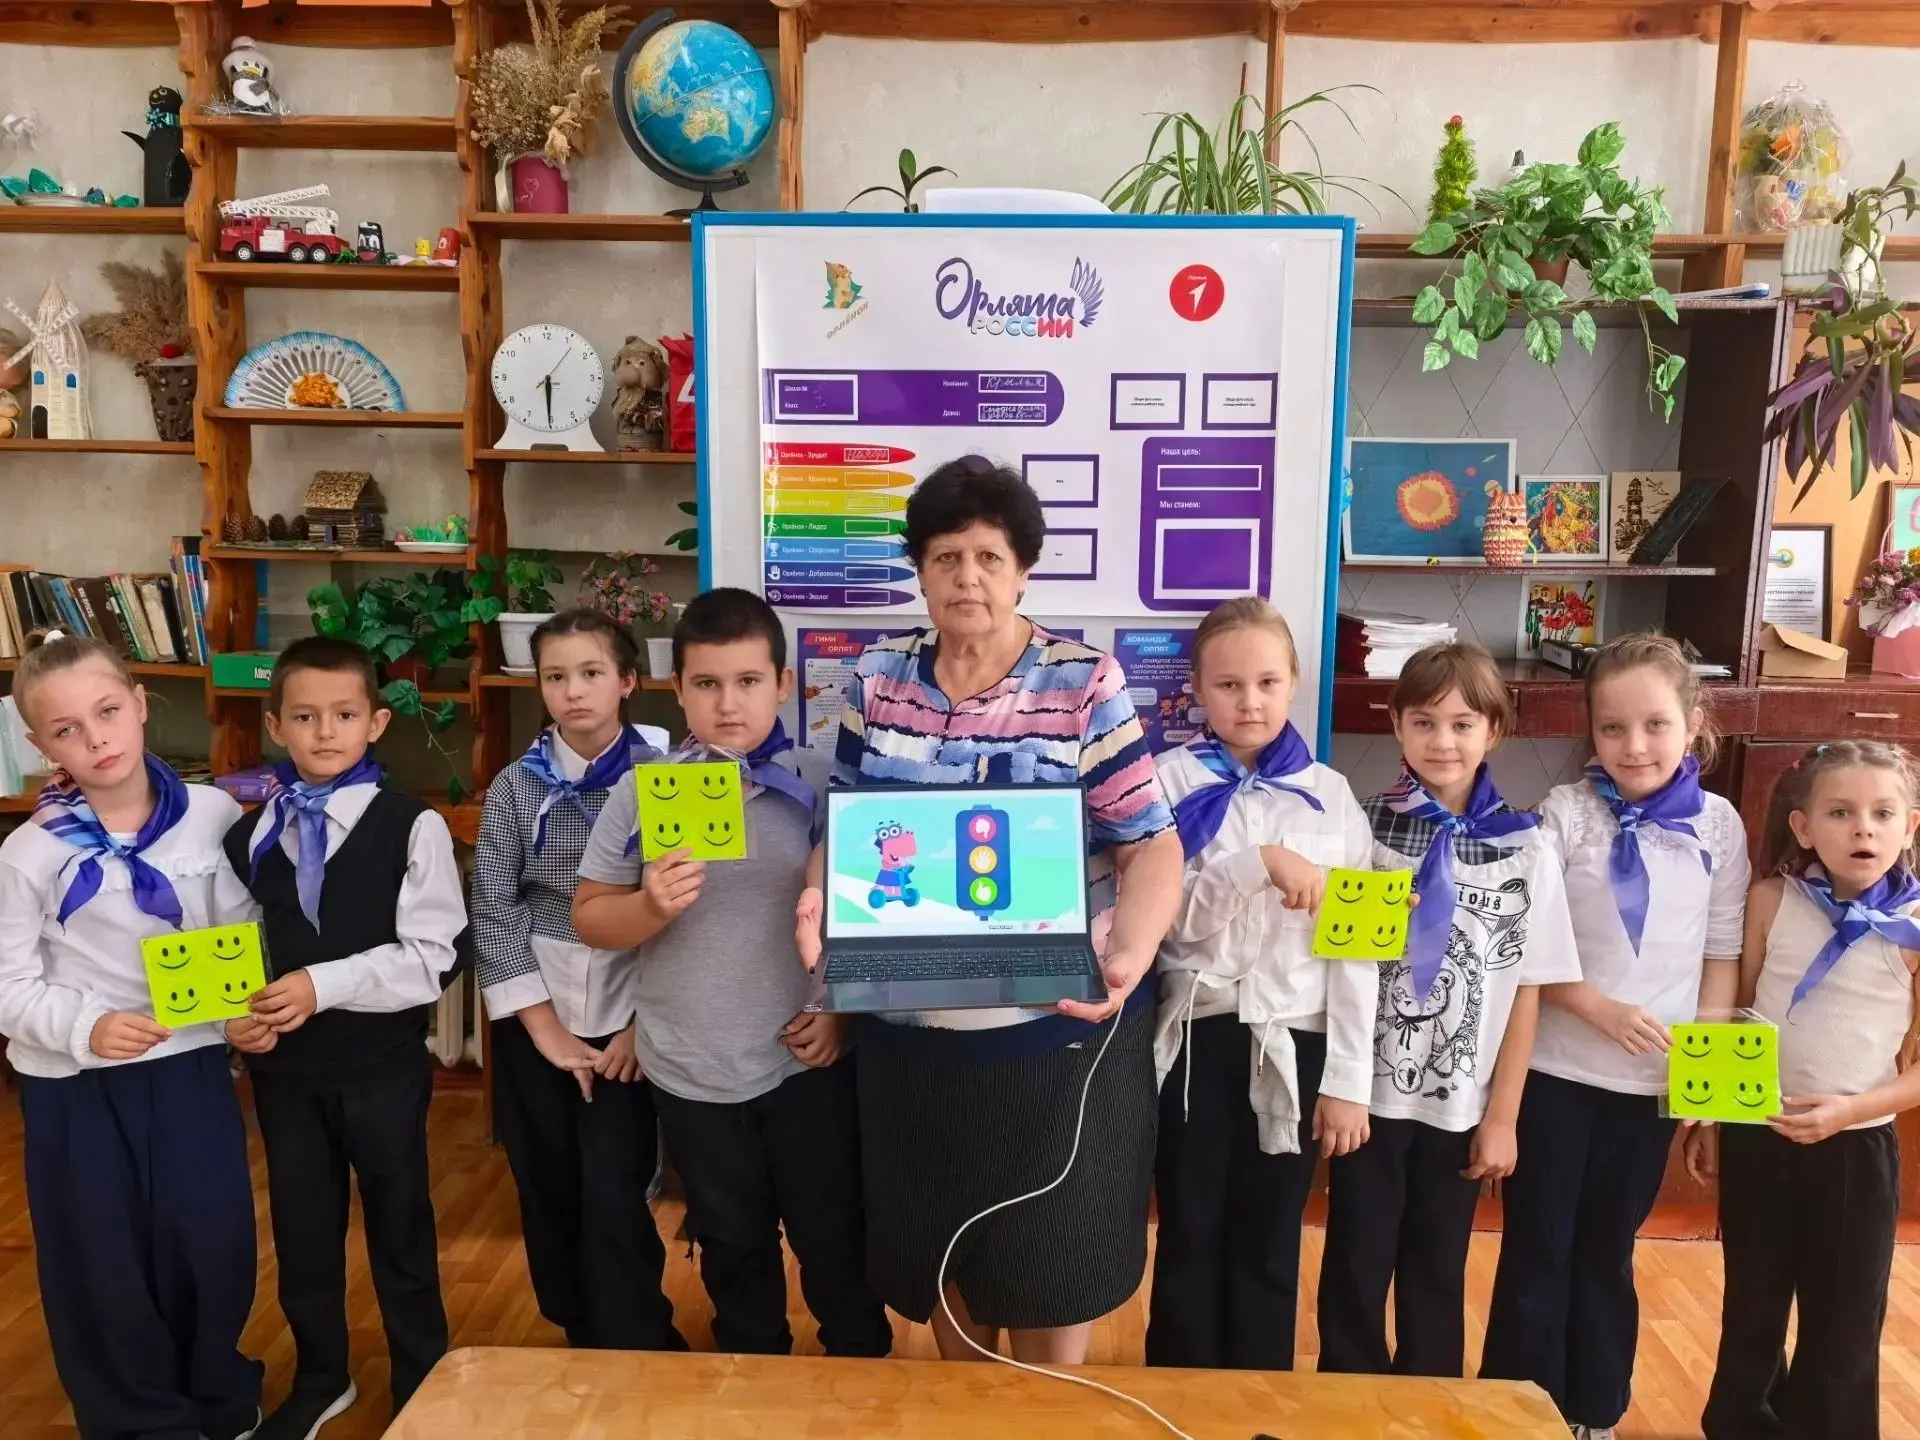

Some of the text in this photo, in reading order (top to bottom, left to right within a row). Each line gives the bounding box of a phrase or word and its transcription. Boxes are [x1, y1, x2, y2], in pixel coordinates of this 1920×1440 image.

[936, 256, 1075, 327] Орлята
[970, 315, 1073, 338] РОССИИ
[1182, 448, 1201, 456] цель:
